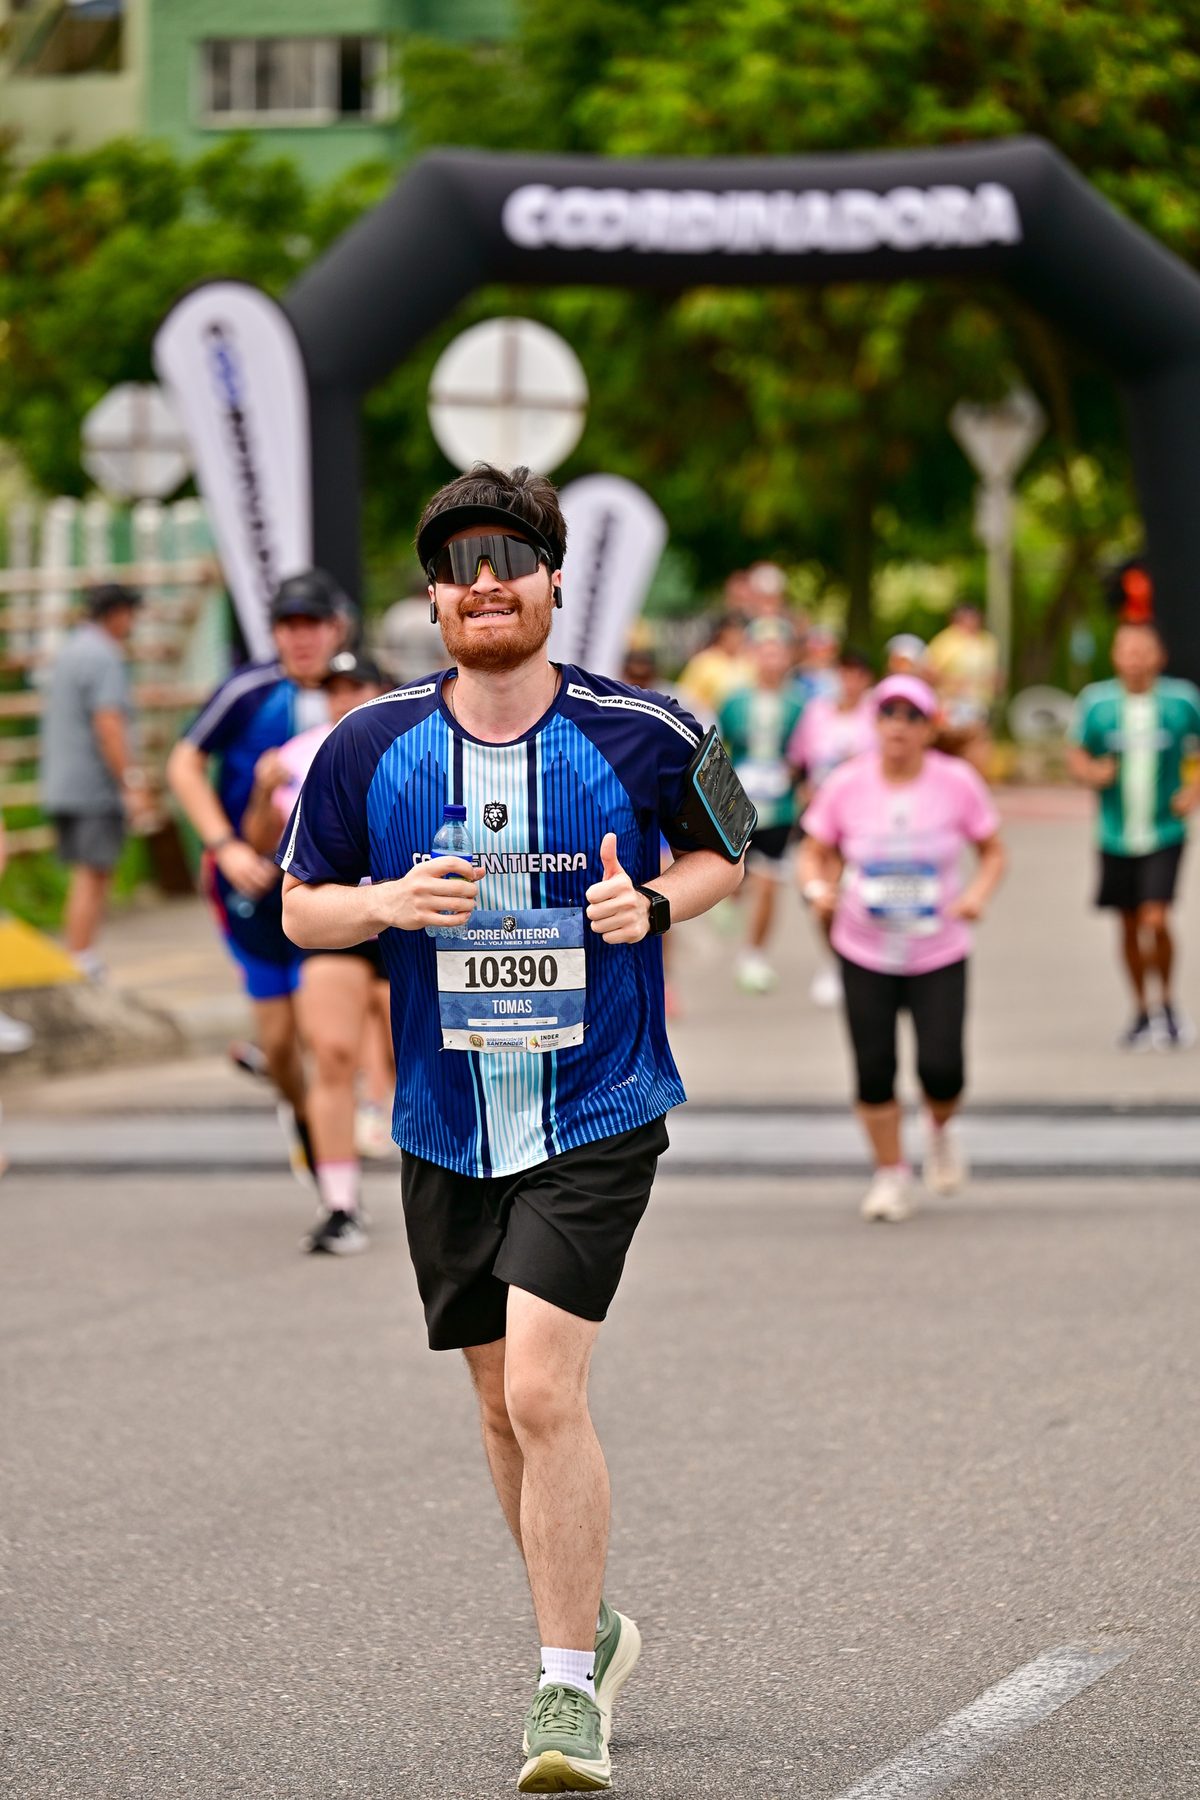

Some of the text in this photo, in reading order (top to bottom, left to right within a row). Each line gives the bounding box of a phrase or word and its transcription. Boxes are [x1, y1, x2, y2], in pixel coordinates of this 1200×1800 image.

[624, 700, 682, 730] CORREMITIERRA
[464, 955, 558, 989] 10390
[492, 999, 533, 1014] TOMAS
[540, 1033, 560, 1041] INDER
